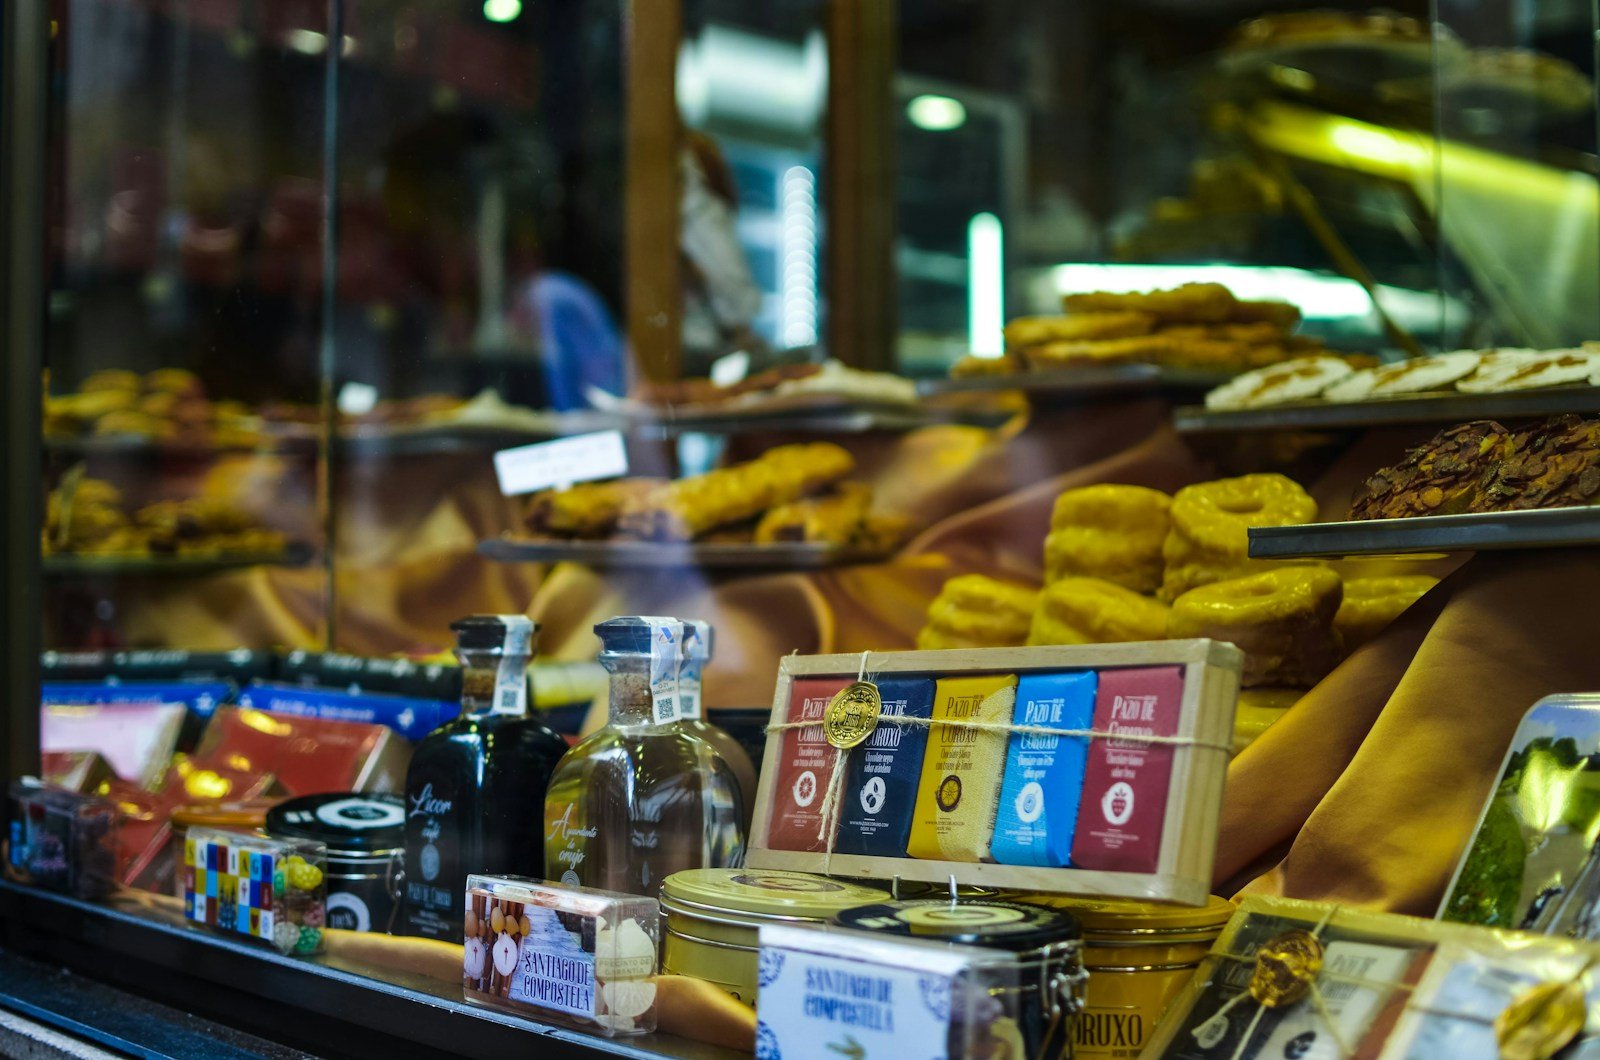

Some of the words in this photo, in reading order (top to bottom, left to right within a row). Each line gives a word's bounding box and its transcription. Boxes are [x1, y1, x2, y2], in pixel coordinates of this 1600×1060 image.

[945, 697, 968, 717] PAZO
[970, 699, 984, 717] DE
[1024, 700, 1049, 723] PAZO
[1050, 703, 1064, 723] DE
[1111, 695, 1140, 720] PAZO
[1140, 699, 1158, 721] DE
[941, 723, 979, 743] CORUXO
[559, 849, 586, 870] orujo
[525, 951, 575, 982] SANTIAGO
[577, 960, 591, 986] DE
[524, 975, 590, 1011] COMPOSTELA
[805, 965, 872, 1000] SANTIAGO
[874, 976, 893, 1004] DE
[803, 992, 895, 1033] COMPOSTELA
